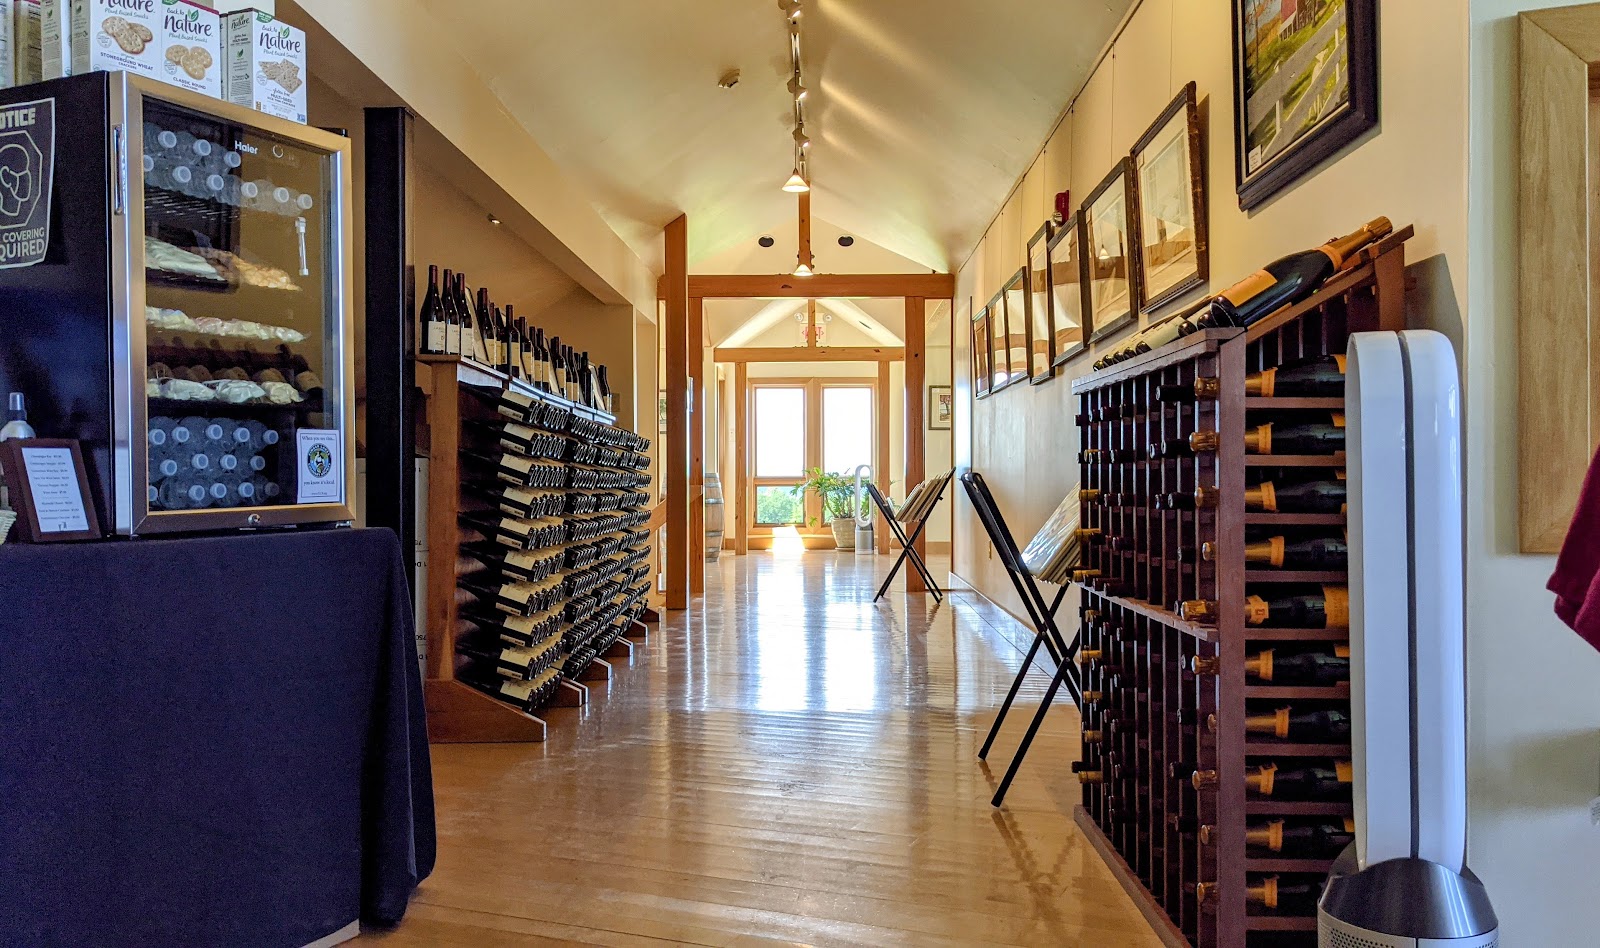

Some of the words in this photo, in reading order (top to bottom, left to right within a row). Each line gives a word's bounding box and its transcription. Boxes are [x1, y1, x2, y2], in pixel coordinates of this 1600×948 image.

[100, 51, 137, 66] STONEGROUND
[137, 63, 154, 71] WHEAT
[235, 140, 258, 155] Haier
[2, 226, 45, 243] COVERING
